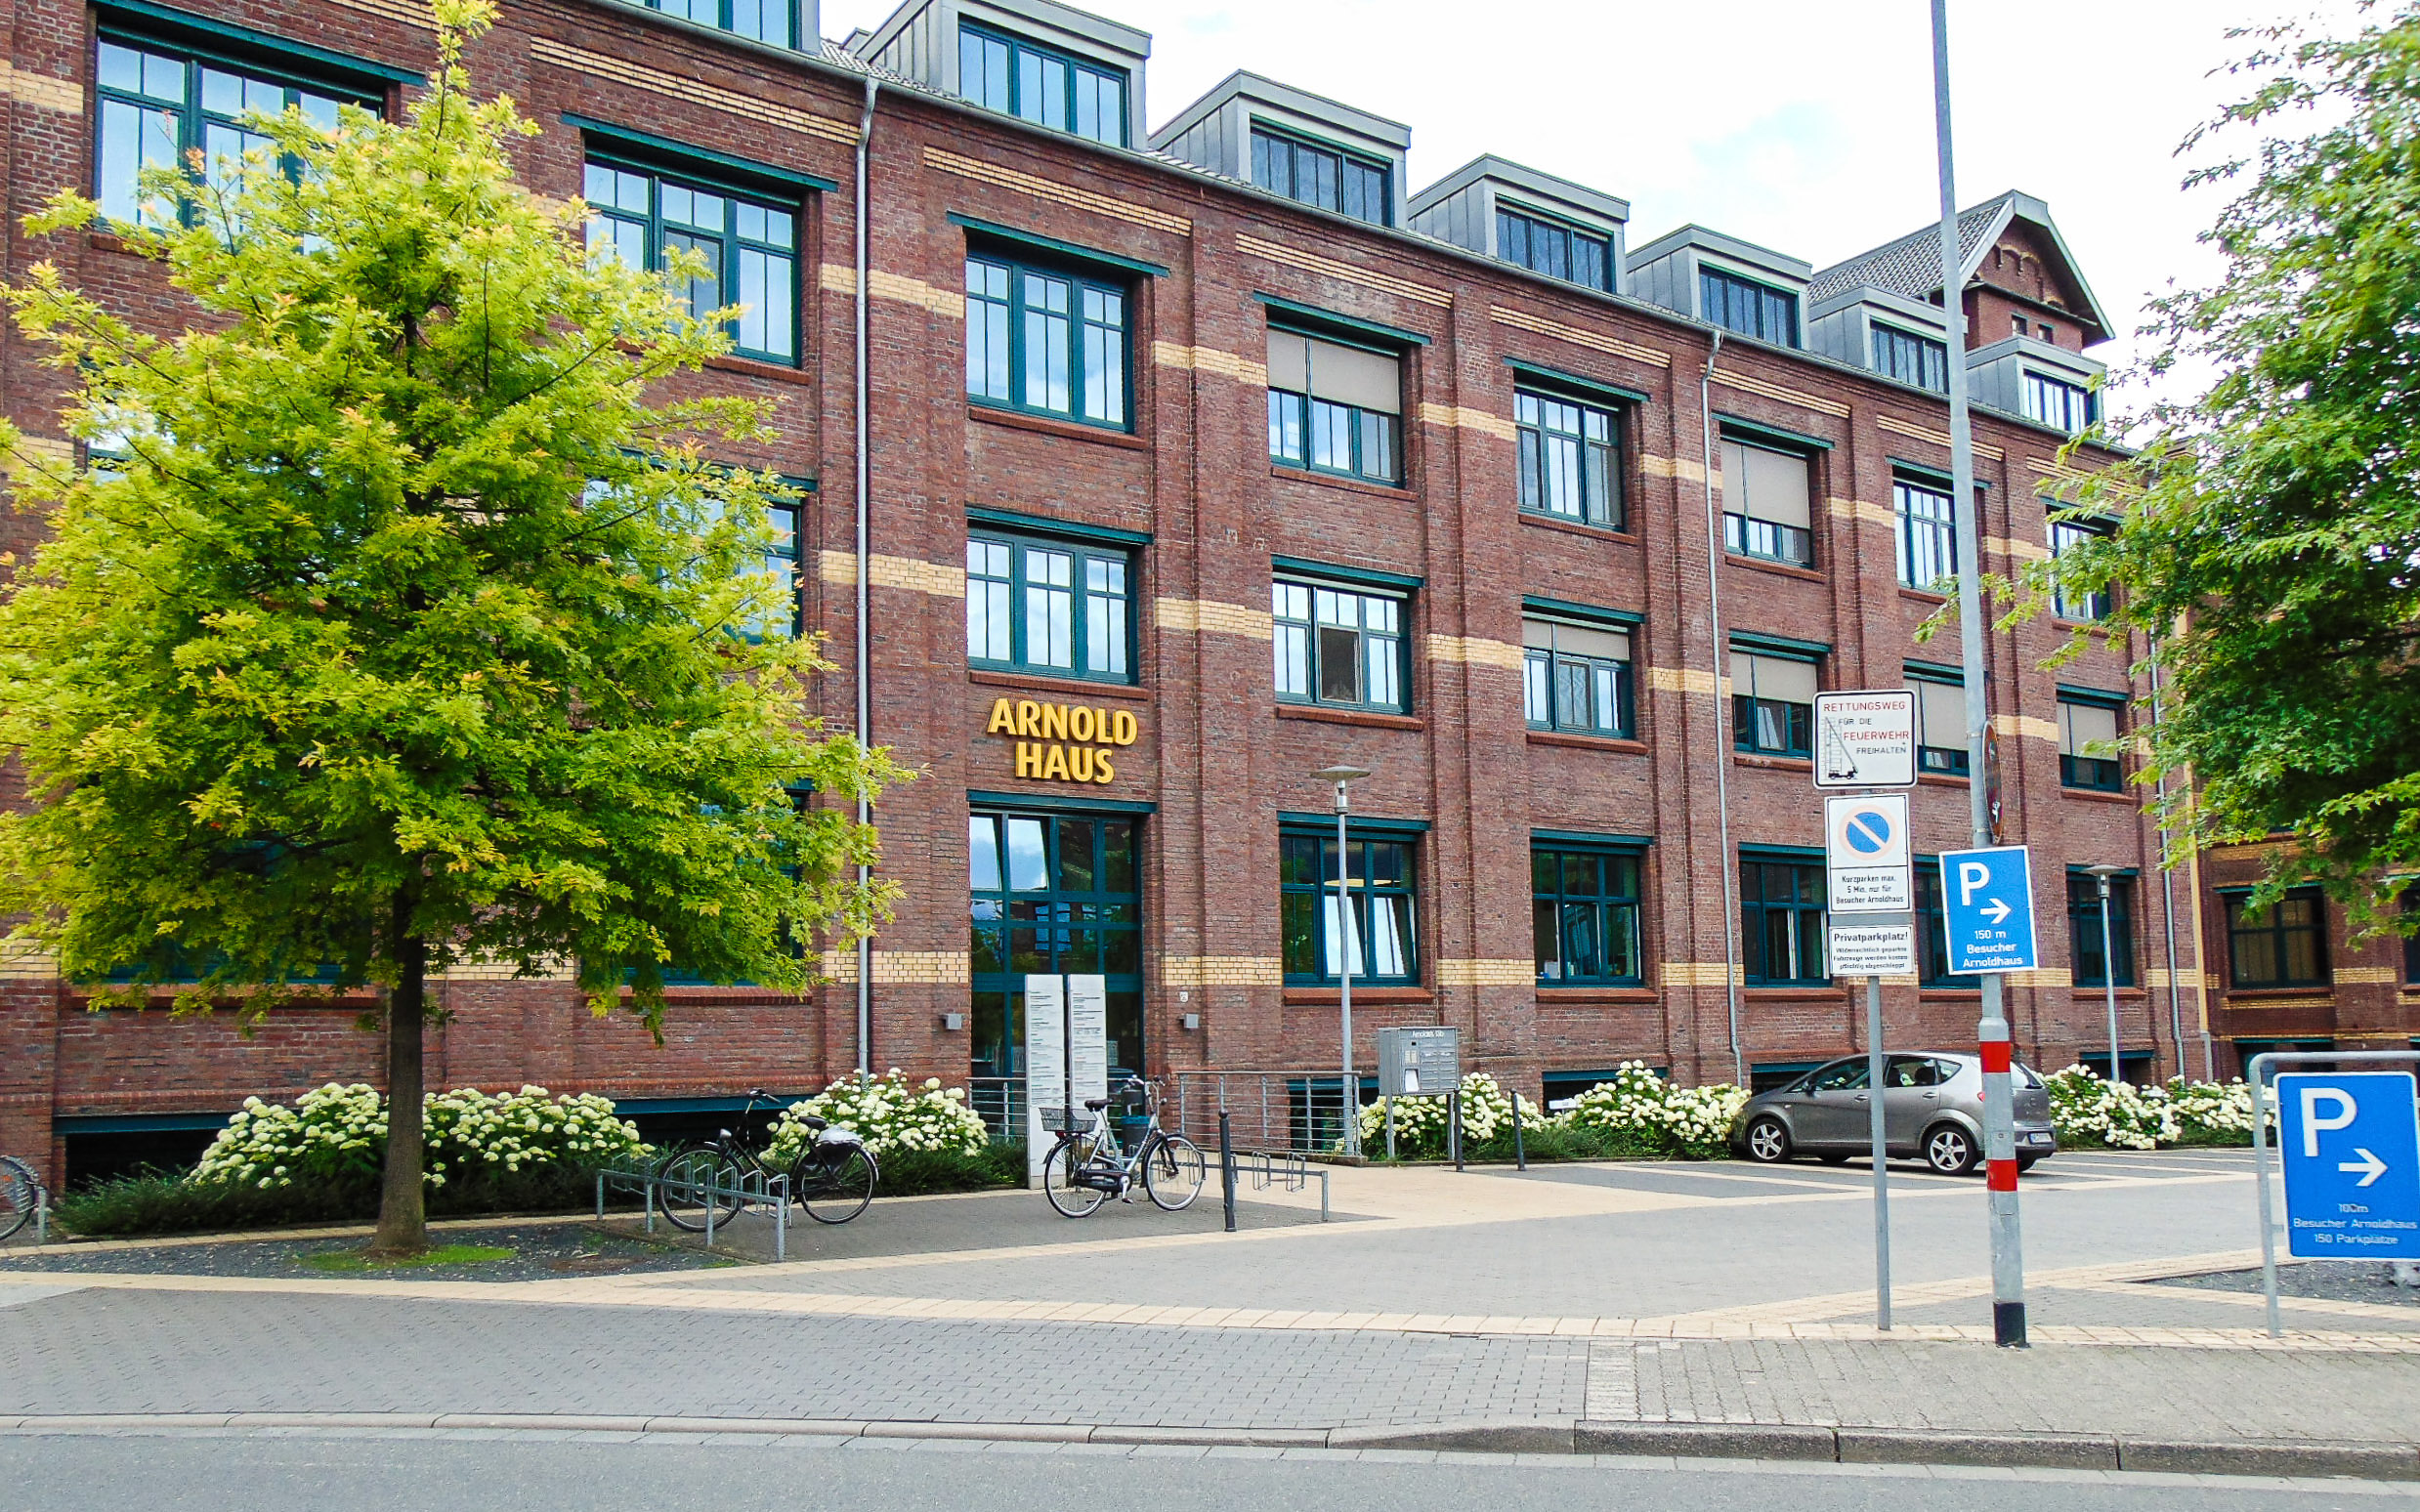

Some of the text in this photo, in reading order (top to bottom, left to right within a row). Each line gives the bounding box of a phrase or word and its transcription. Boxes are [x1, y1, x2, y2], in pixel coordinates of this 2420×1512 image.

[1823, 701, 1906, 712] RETTUNGSWEG
[987, 697, 1138, 746] ARNOLD
[1838, 717, 1854, 726] FÜR
[1844, 731, 1909, 741] FEUERWEHR
[1856, 746, 1906, 755] FREIHALTEN
[1015, 741, 1115, 784] HAUS
[1842, 875, 1880, 884] Kurzparken
[1959, 861, 1990, 906] P
[1834, 931, 1908, 944] Privatparkplatz!
[1974, 930, 1992, 940] 150
[1966, 943, 2017, 954] Besucher
[1962, 956, 2023, 968] Arnoldhaus
[2301, 1088, 2357, 1156] P
[2293, 1218, 2418, 1229] Besucher Arnoldhaus
[2314, 1234, 2333, 1243] 150
